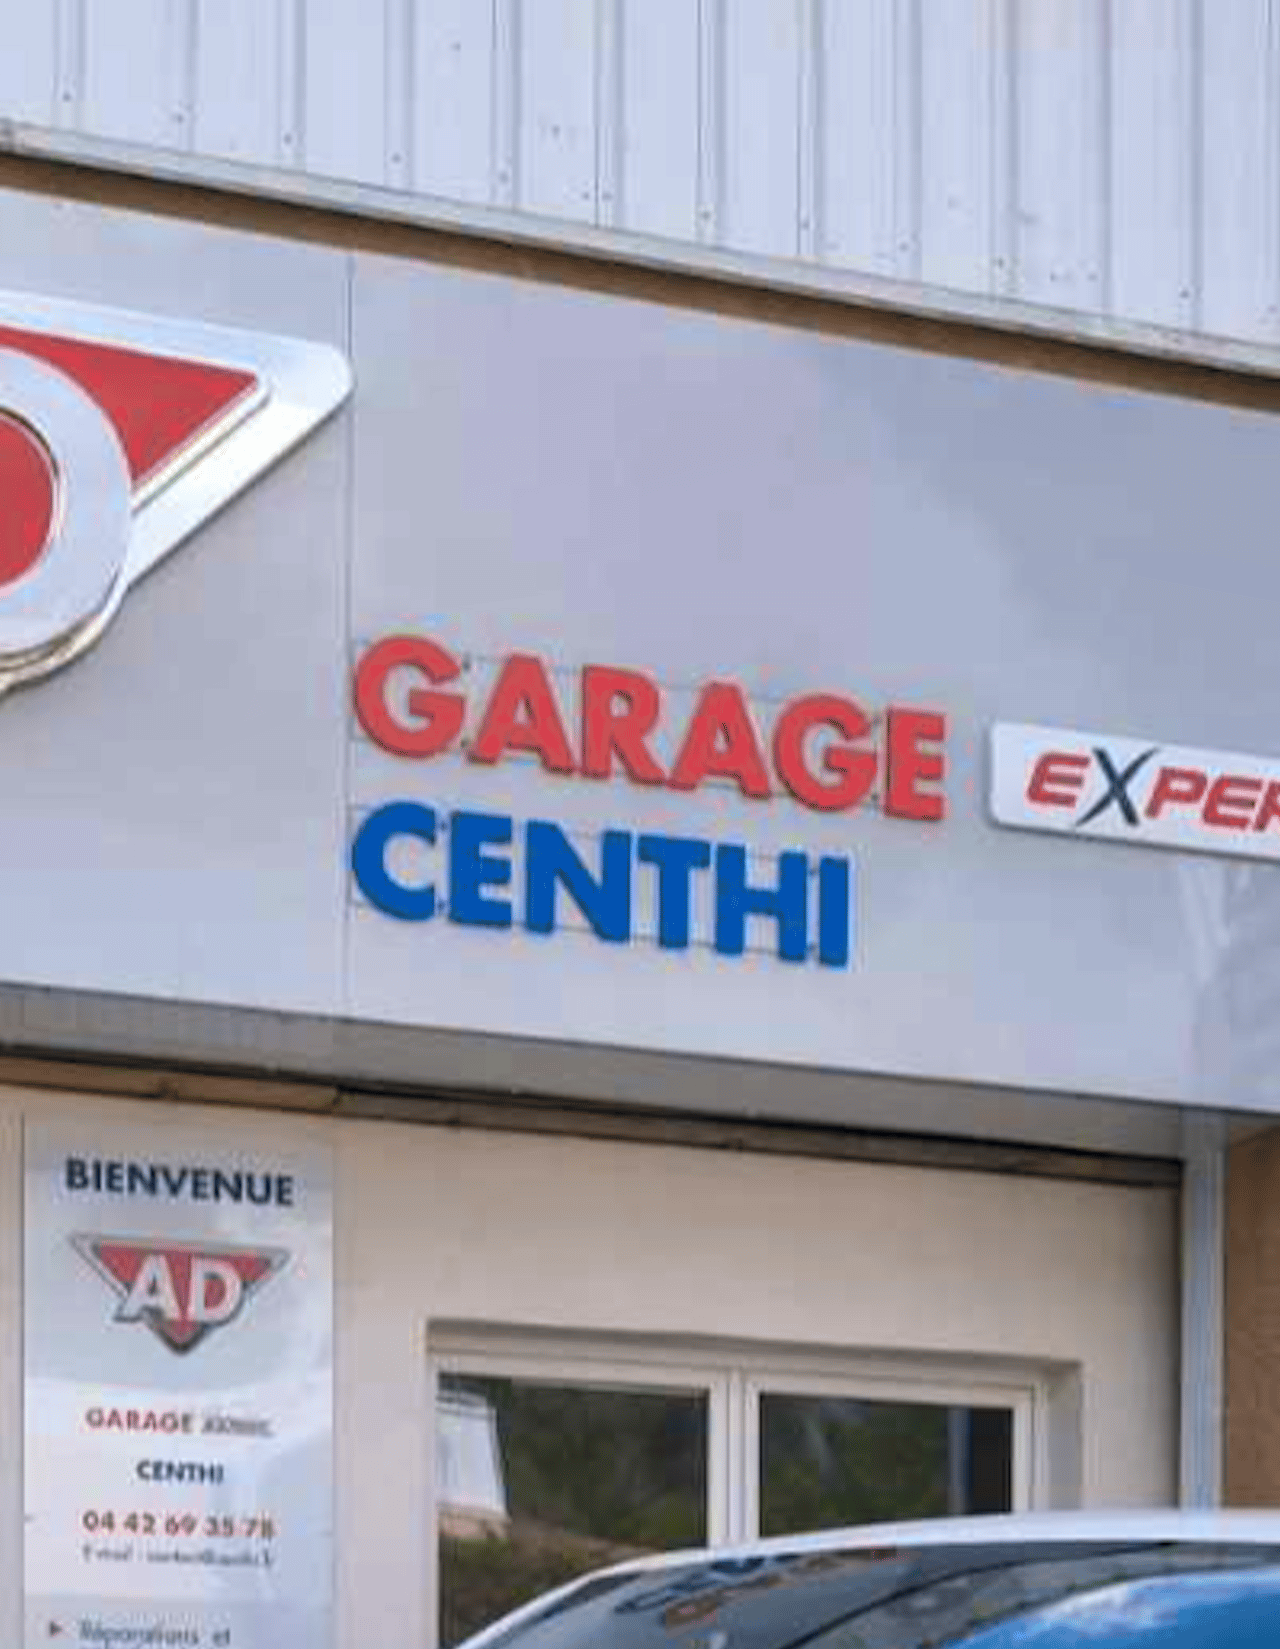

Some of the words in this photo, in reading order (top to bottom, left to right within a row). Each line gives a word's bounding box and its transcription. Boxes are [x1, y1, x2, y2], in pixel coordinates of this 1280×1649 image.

[353, 634, 947, 822] GARAGE
[352, 801, 850, 967] CENTHI
[65, 1156, 295, 1206] BIENVENUE
[118, 1254, 243, 1323] AD
[85, 1406, 194, 1435] GARAGE
[136, 1458, 224, 1483] CENTHI
[82, 1509, 115, 1533] 04
[123, 1511, 156, 1536] 42
